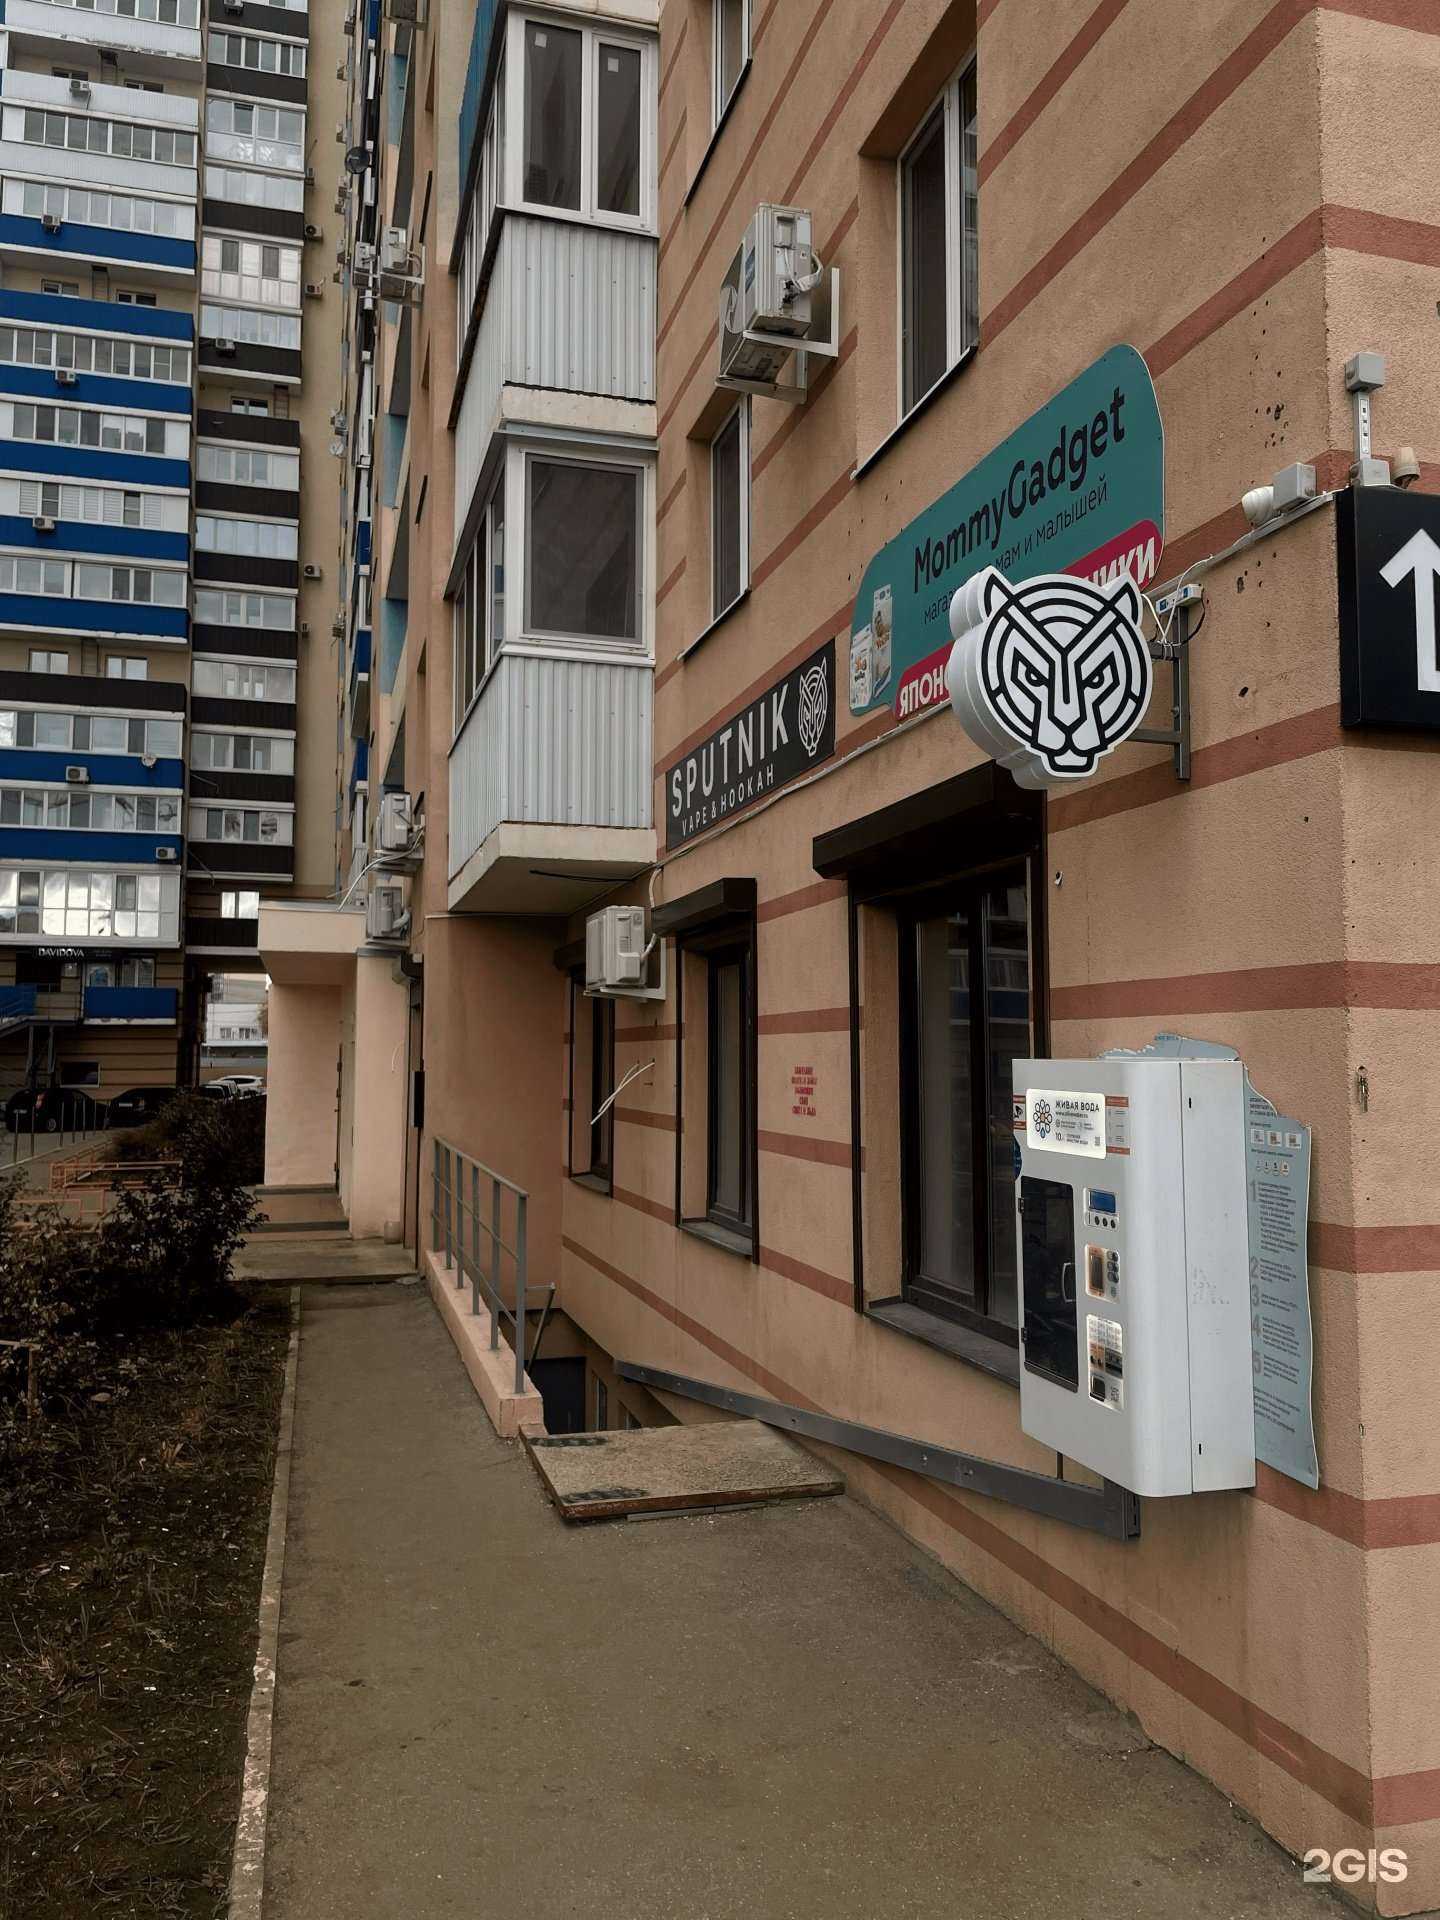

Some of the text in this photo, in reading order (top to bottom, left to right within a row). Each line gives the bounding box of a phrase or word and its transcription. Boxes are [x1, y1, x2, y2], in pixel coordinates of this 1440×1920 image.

[913, 386, 1125, 593] MommyGadget
[995, 544, 1020, 572] мам
[1024, 533, 1033, 557] и
[1036, 473, 1108, 547] малышей
[899, 664, 949, 718] ЯПОН
[672, 683, 789, 817] SPUTNIK
[682, 806, 707, 836] VAPE
[720, 764, 774, 814] HOOKAH
[38, 947, 85, 958] DAVIDOVA
[1055, 1099, 1100, 1113] ЖИВАЯ ВОДА
